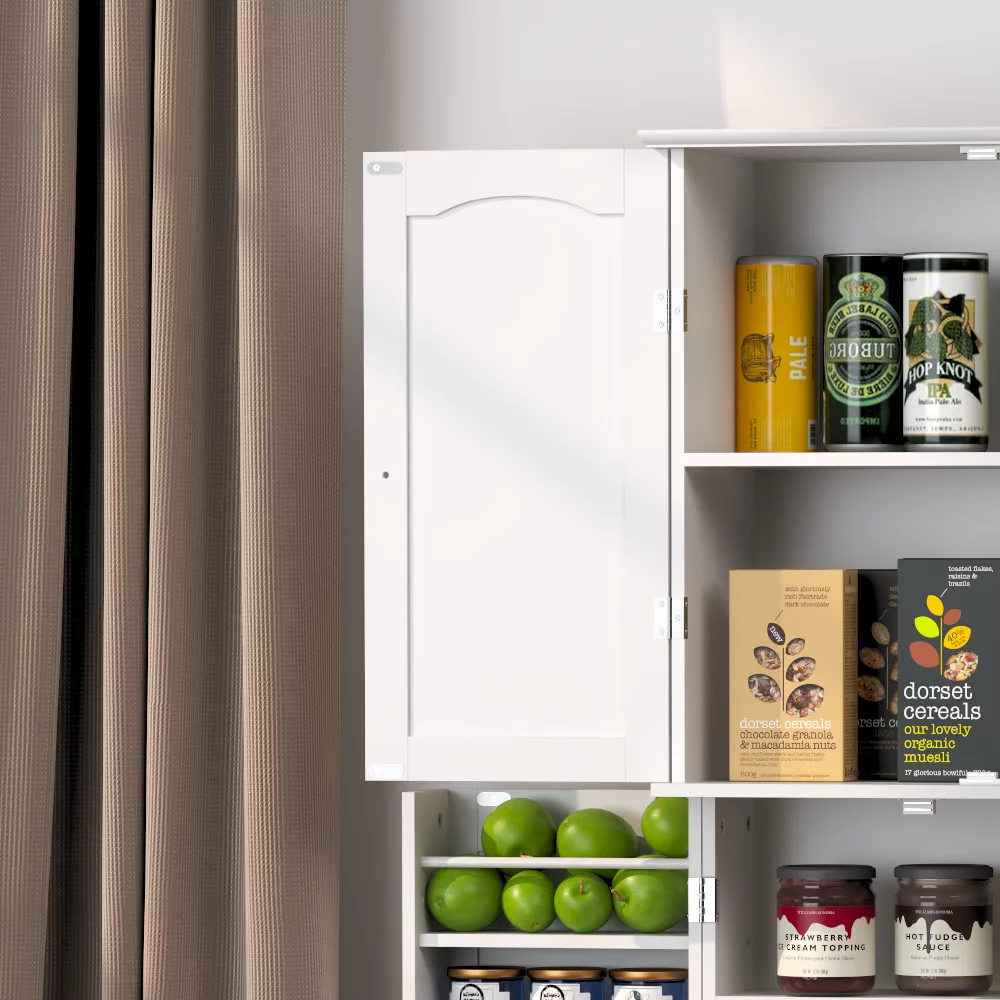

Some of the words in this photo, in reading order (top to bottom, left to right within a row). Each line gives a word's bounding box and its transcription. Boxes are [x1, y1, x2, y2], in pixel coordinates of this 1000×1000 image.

[790, 336, 807, 380] PALE
[909, 362, 932, 385] HOP
[936, 361, 973, 384] KNOT
[927, 383, 951, 398] IPA
[904, 682, 972, 700] dorset
[904, 702, 981, 720] cereals
[739, 717, 781, 729] dorset
[784, 717, 831, 729] cereals
[740, 730, 790, 740] chocolate
[792, 730, 833, 740] granola
[904, 724, 928, 735] our
[931, 723, 972, 737] lovely
[751, 740, 810, 750] macadamia
[813, 742, 836, 750] nuts
[904, 738, 956, 751] organic
[904, 751, 950, 763] muesli
[785, 933, 849, 942] STRAWBERRY
[917, 943, 950, 951] SAUCE
